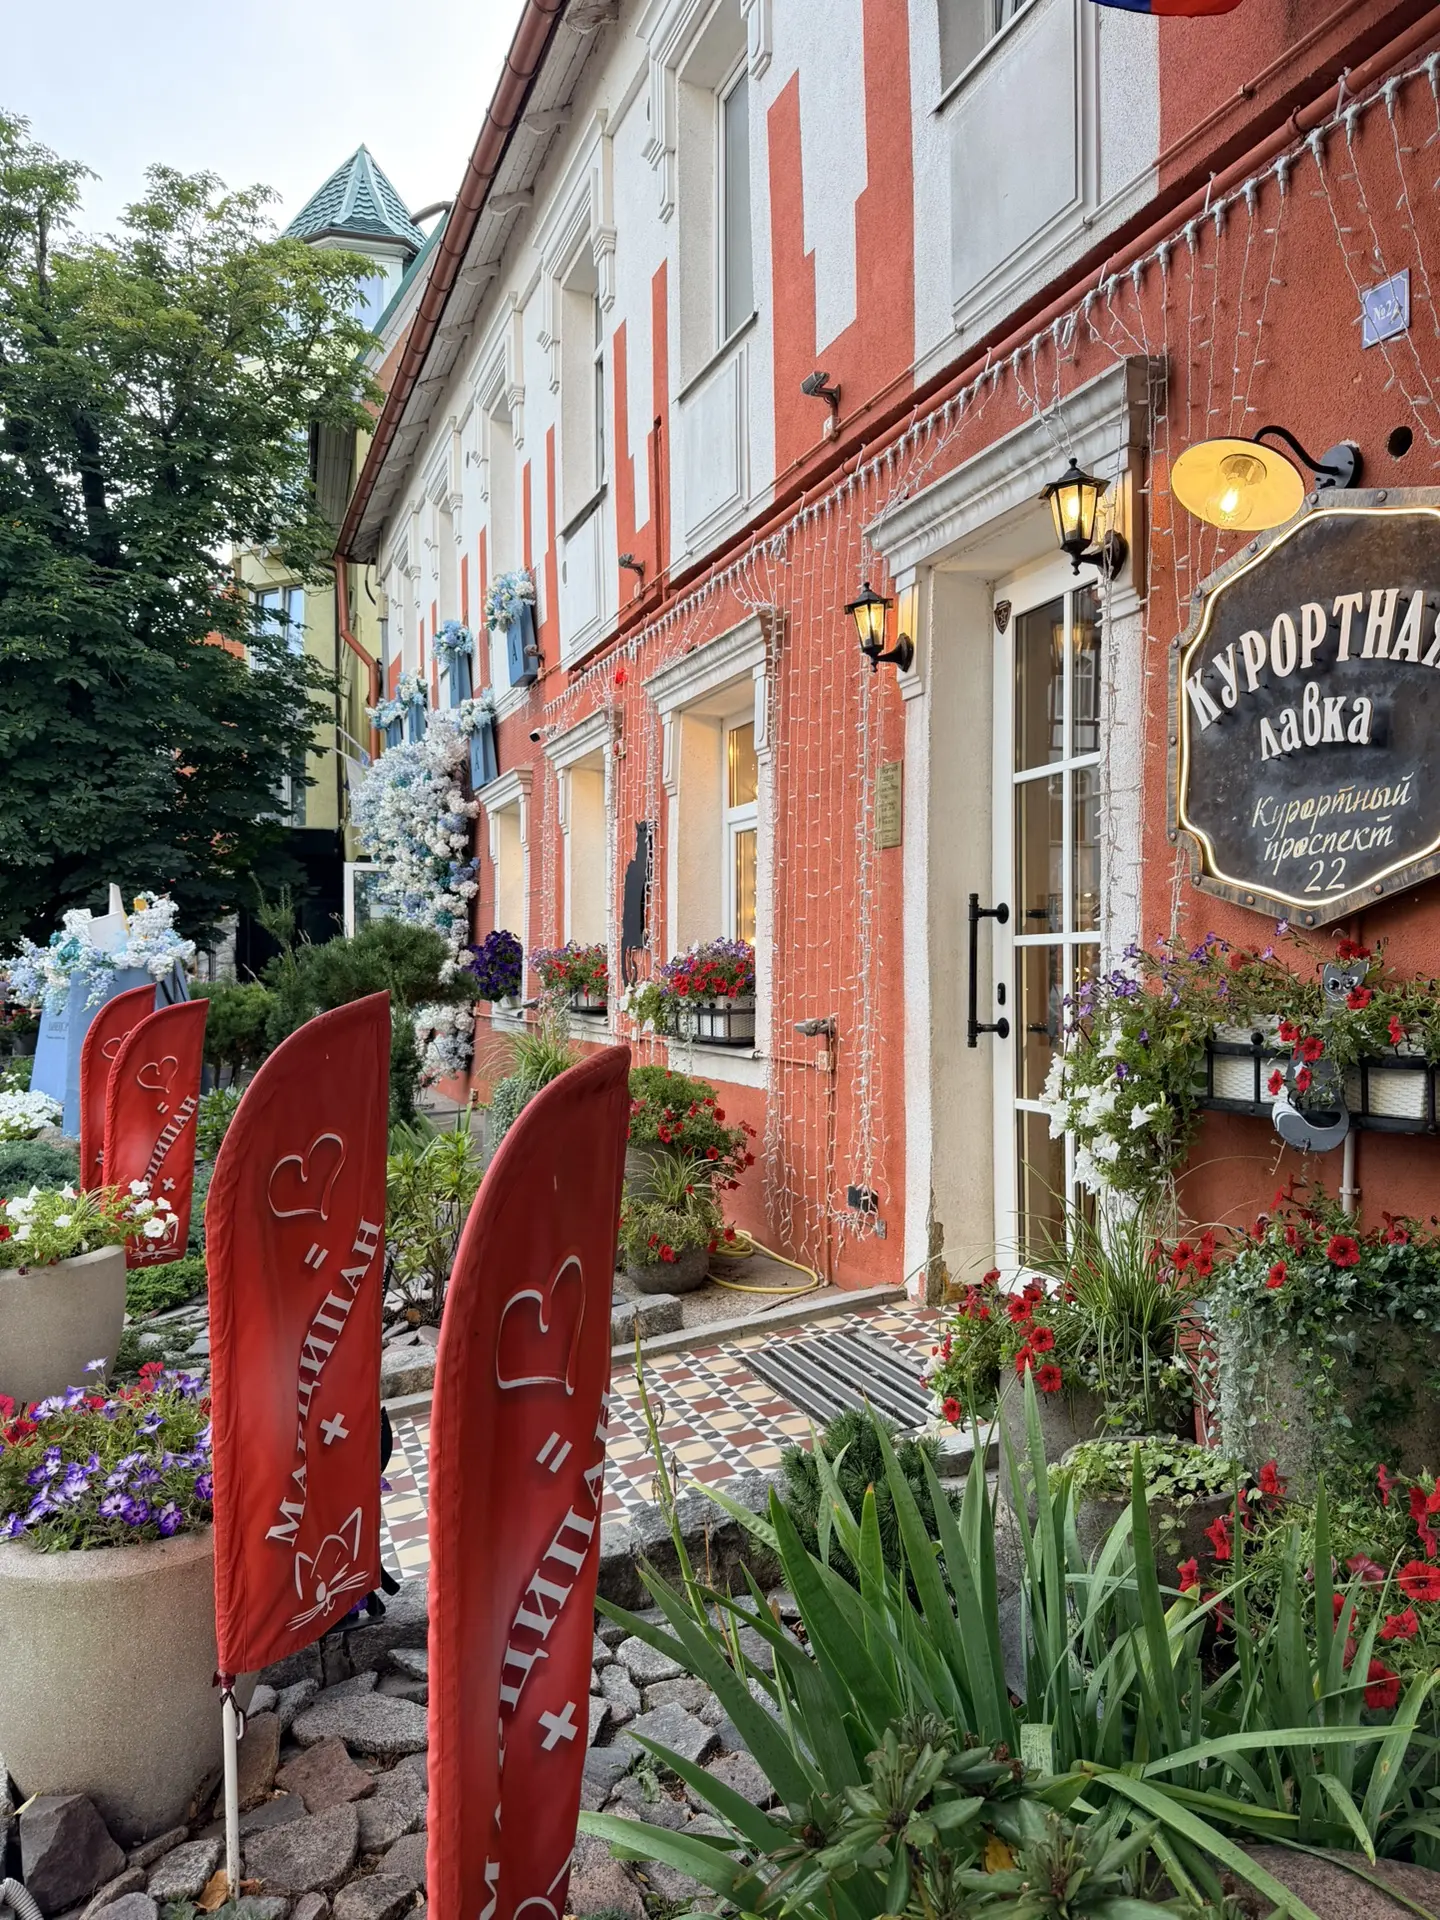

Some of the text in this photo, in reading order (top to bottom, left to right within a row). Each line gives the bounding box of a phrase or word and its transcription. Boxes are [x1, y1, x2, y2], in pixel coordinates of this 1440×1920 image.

[1260, 682, 1372, 762] лавка
[1252, 772, 1414, 840] Курортный
[1264, 815, 1394, 876] проспект
[1304, 857, 1346, 892] 22
